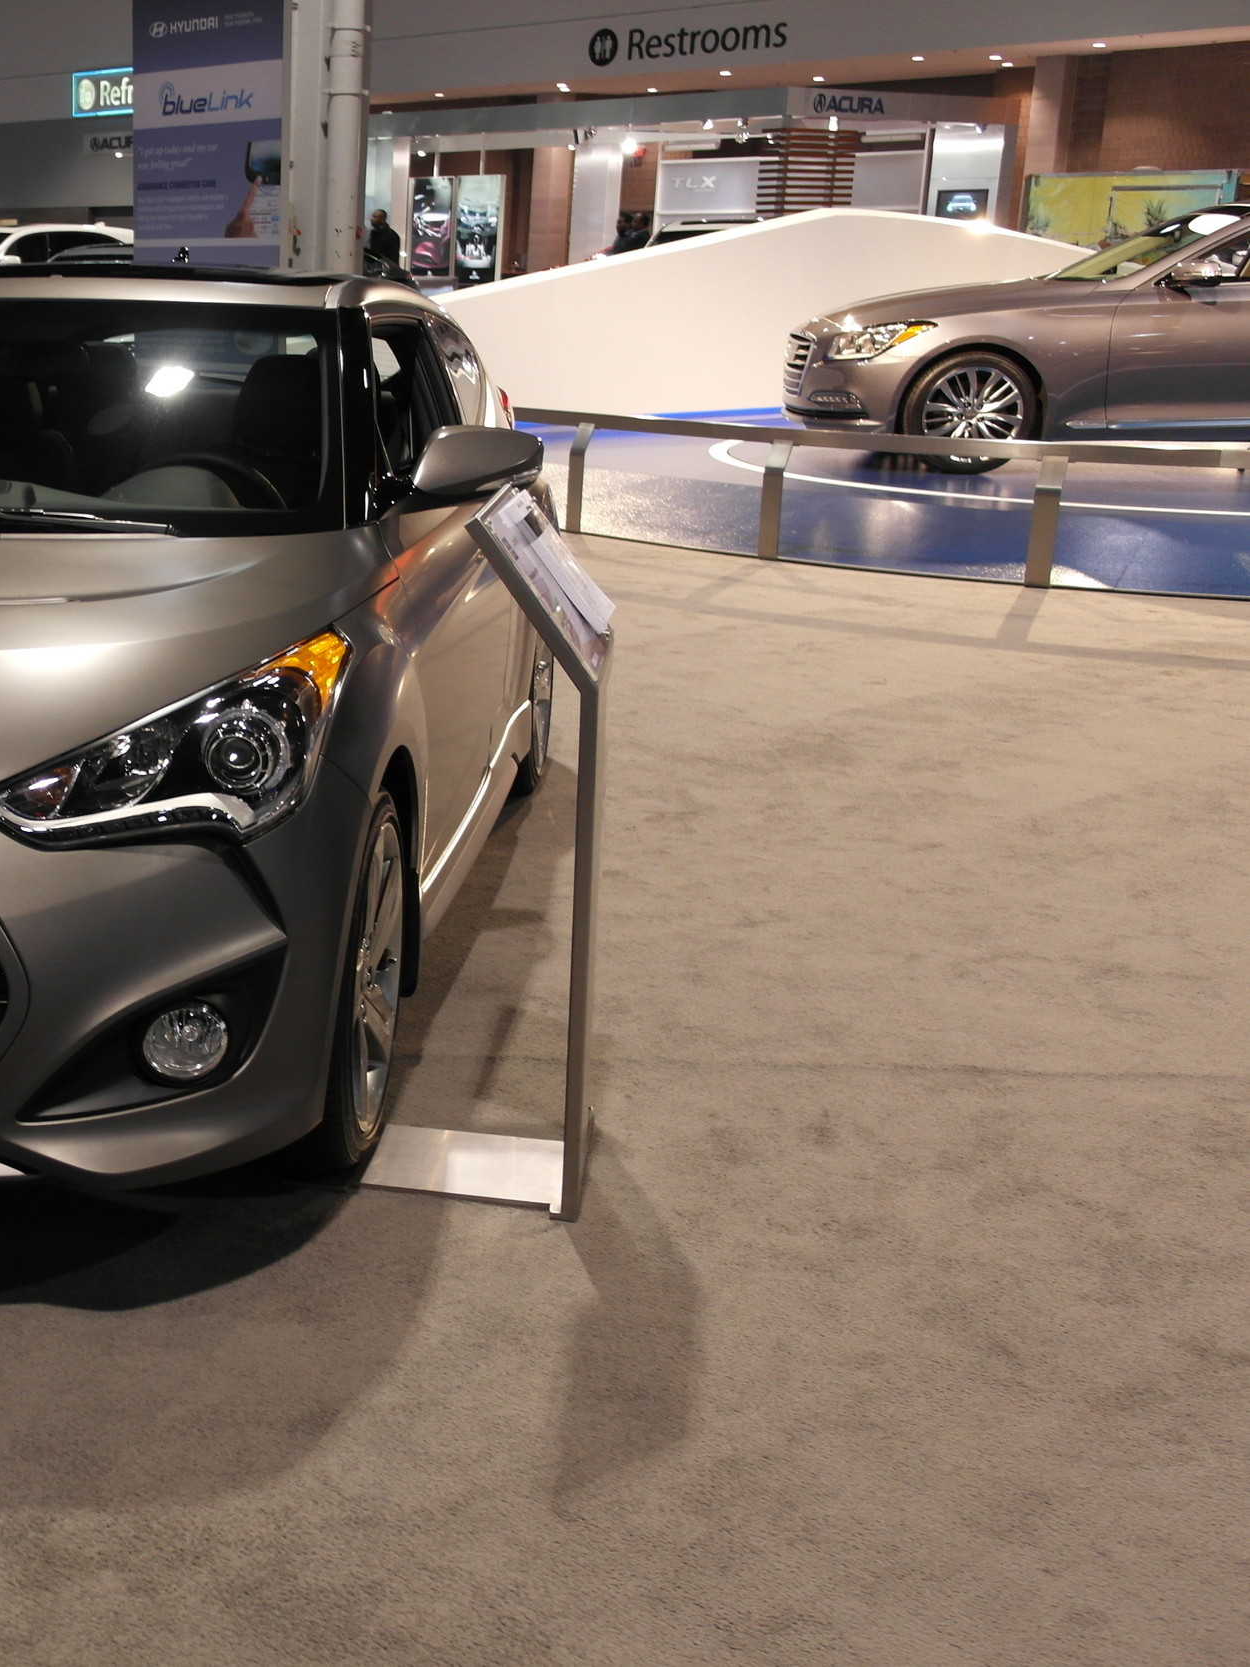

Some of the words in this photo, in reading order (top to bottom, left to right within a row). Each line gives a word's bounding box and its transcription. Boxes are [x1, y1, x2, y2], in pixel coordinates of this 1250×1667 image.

[170, 16, 218, 34] HYUNDAI
[627, 21, 788, 61] Restrooms
[826, 95, 885, 114] ACURA
[672, 175, 717, 190] TLX
